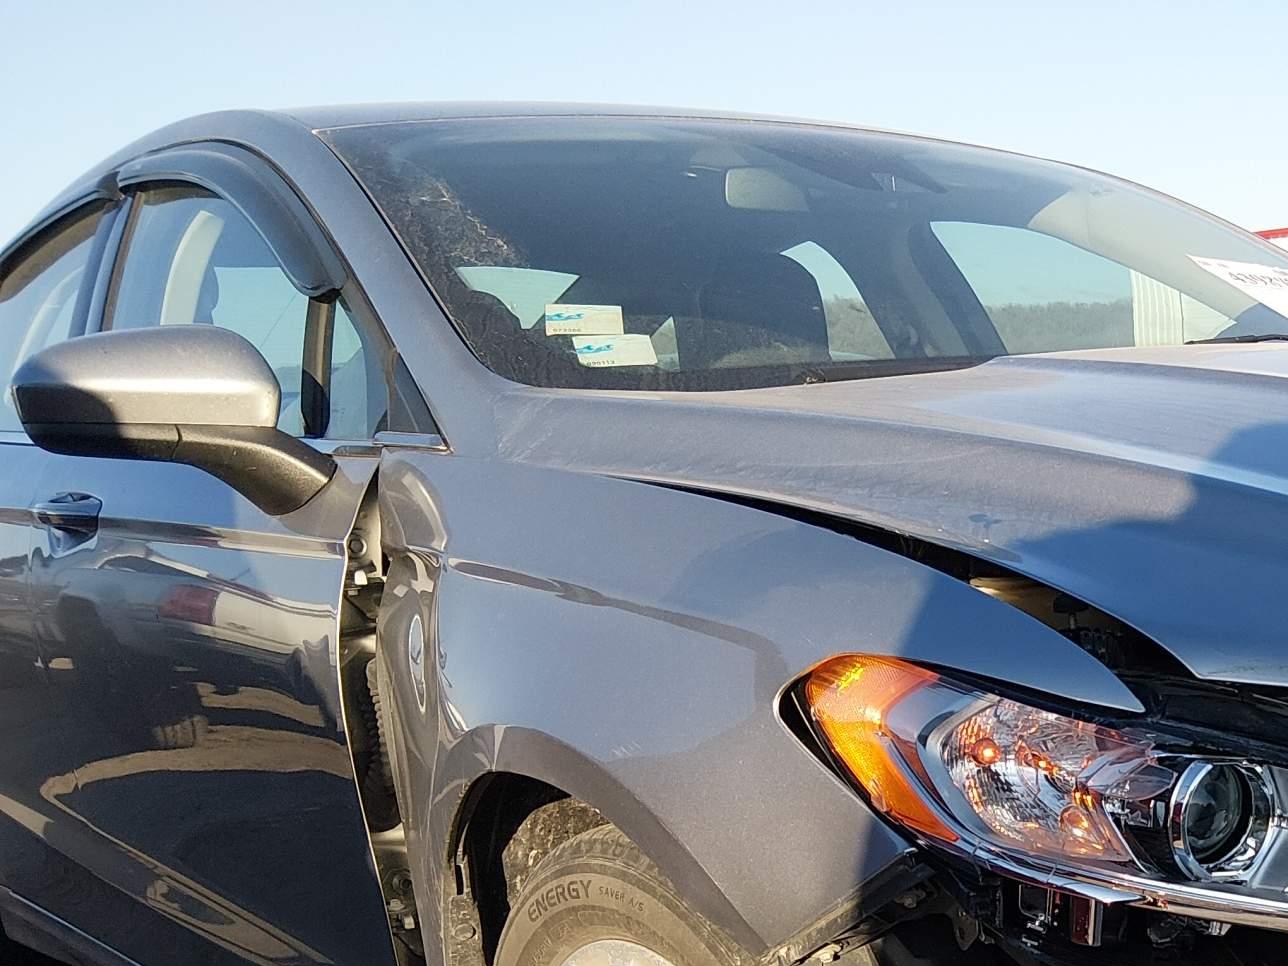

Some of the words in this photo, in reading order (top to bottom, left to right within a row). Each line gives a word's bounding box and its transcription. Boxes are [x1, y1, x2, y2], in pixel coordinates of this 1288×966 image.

[527, 879, 593, 923] ENERGY
[599, 885, 626, 903] SAVER
[629, 896, 645, 912] A/S
